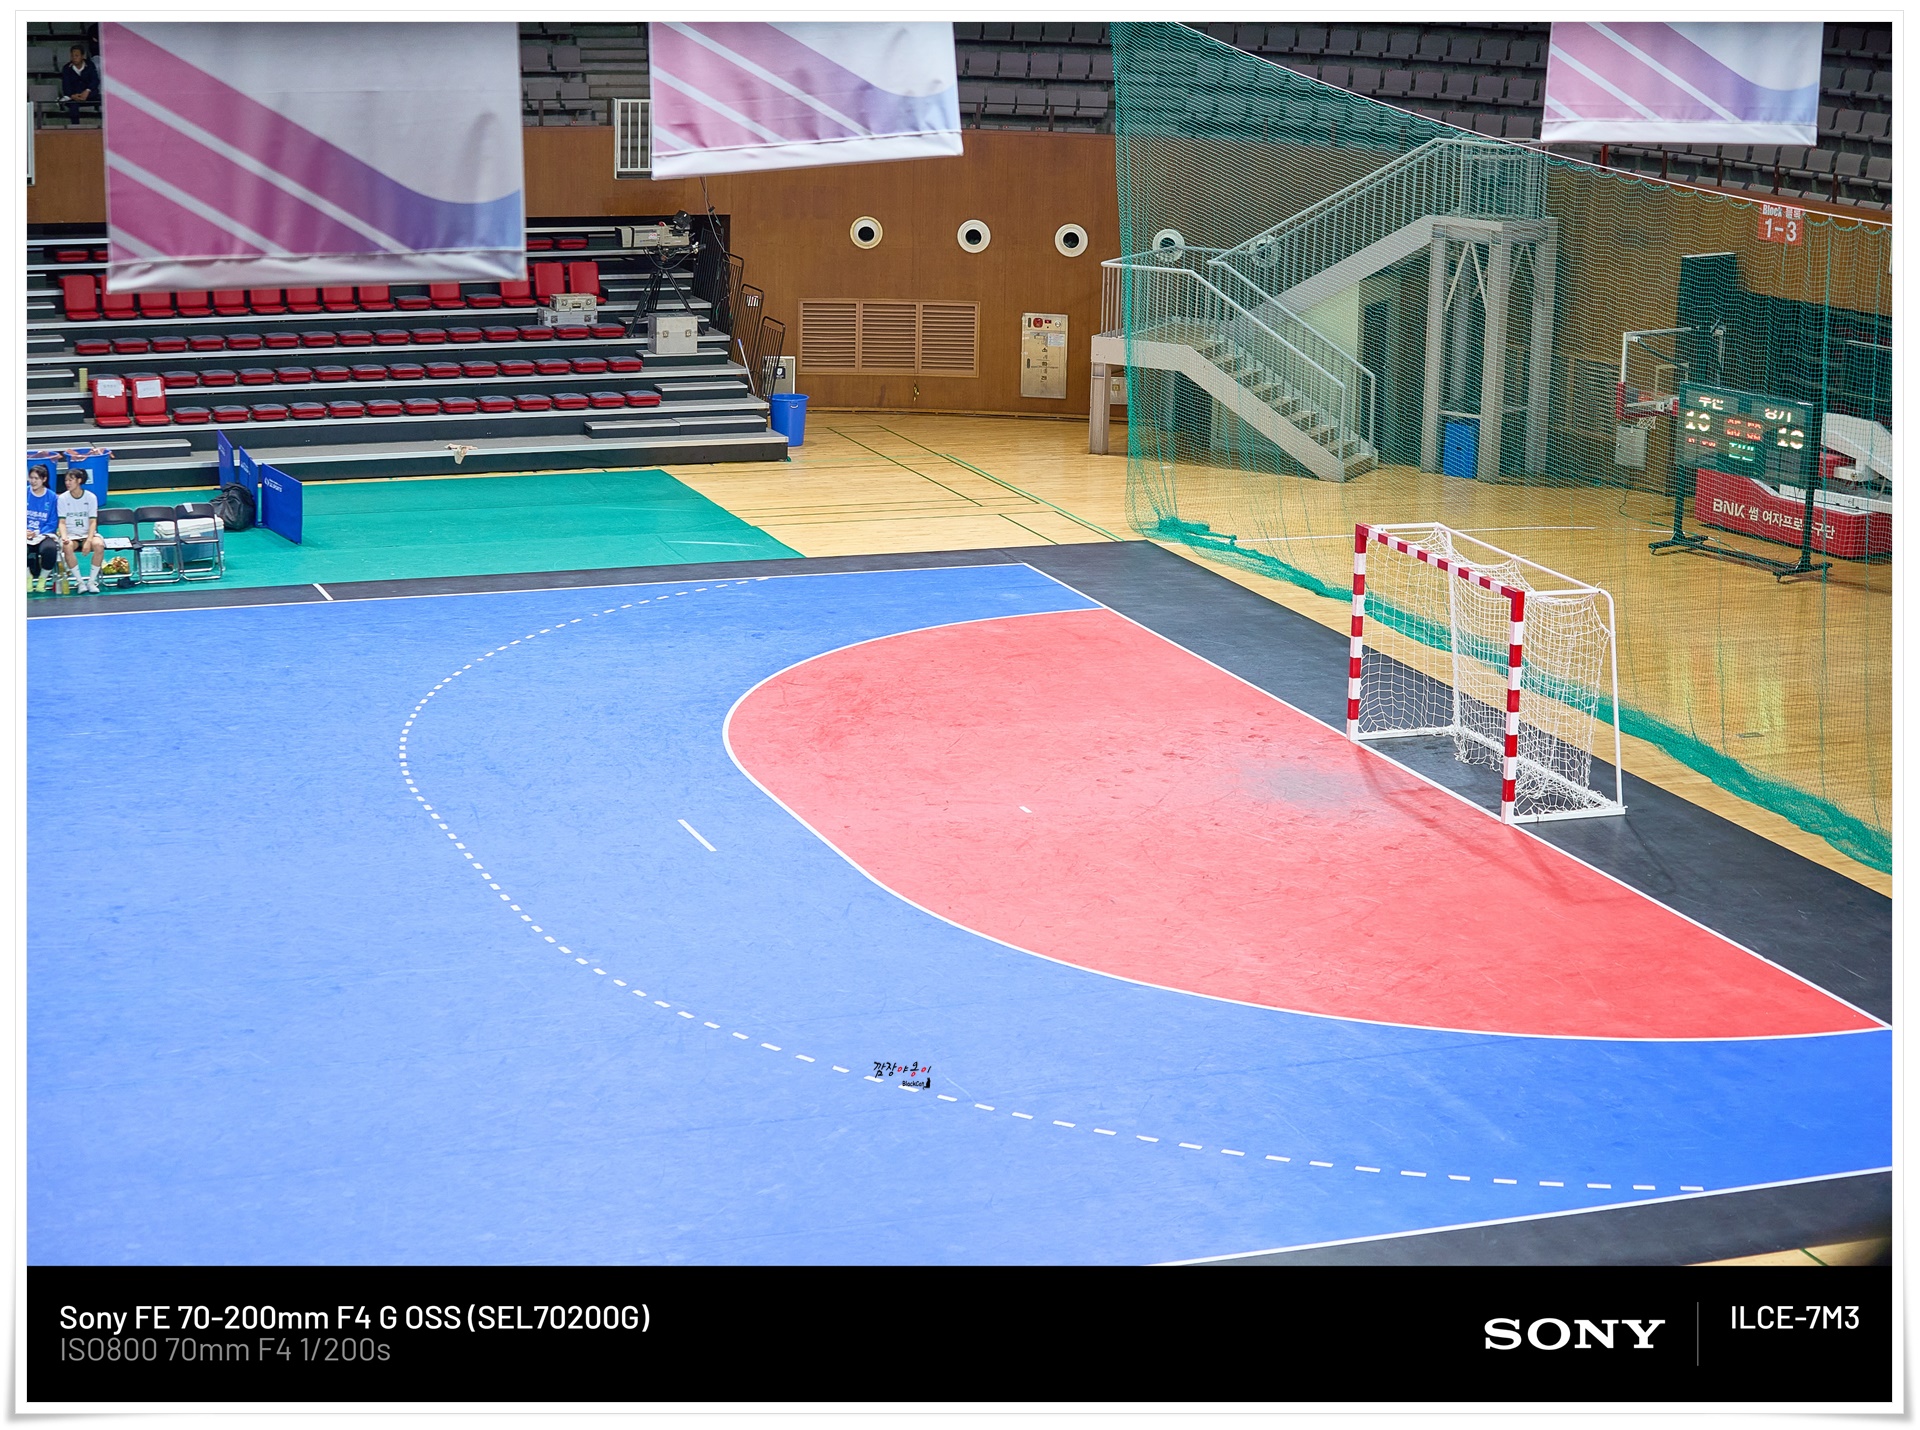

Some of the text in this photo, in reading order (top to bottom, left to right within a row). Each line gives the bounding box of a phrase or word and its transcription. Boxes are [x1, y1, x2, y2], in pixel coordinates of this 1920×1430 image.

[1763, 204, 1782, 217] Block
[1765, 218, 1797, 242] 1-3
[1713, 498, 1745, 519] BNK
[1762, 510, 1835, 540] 여자프로구단
